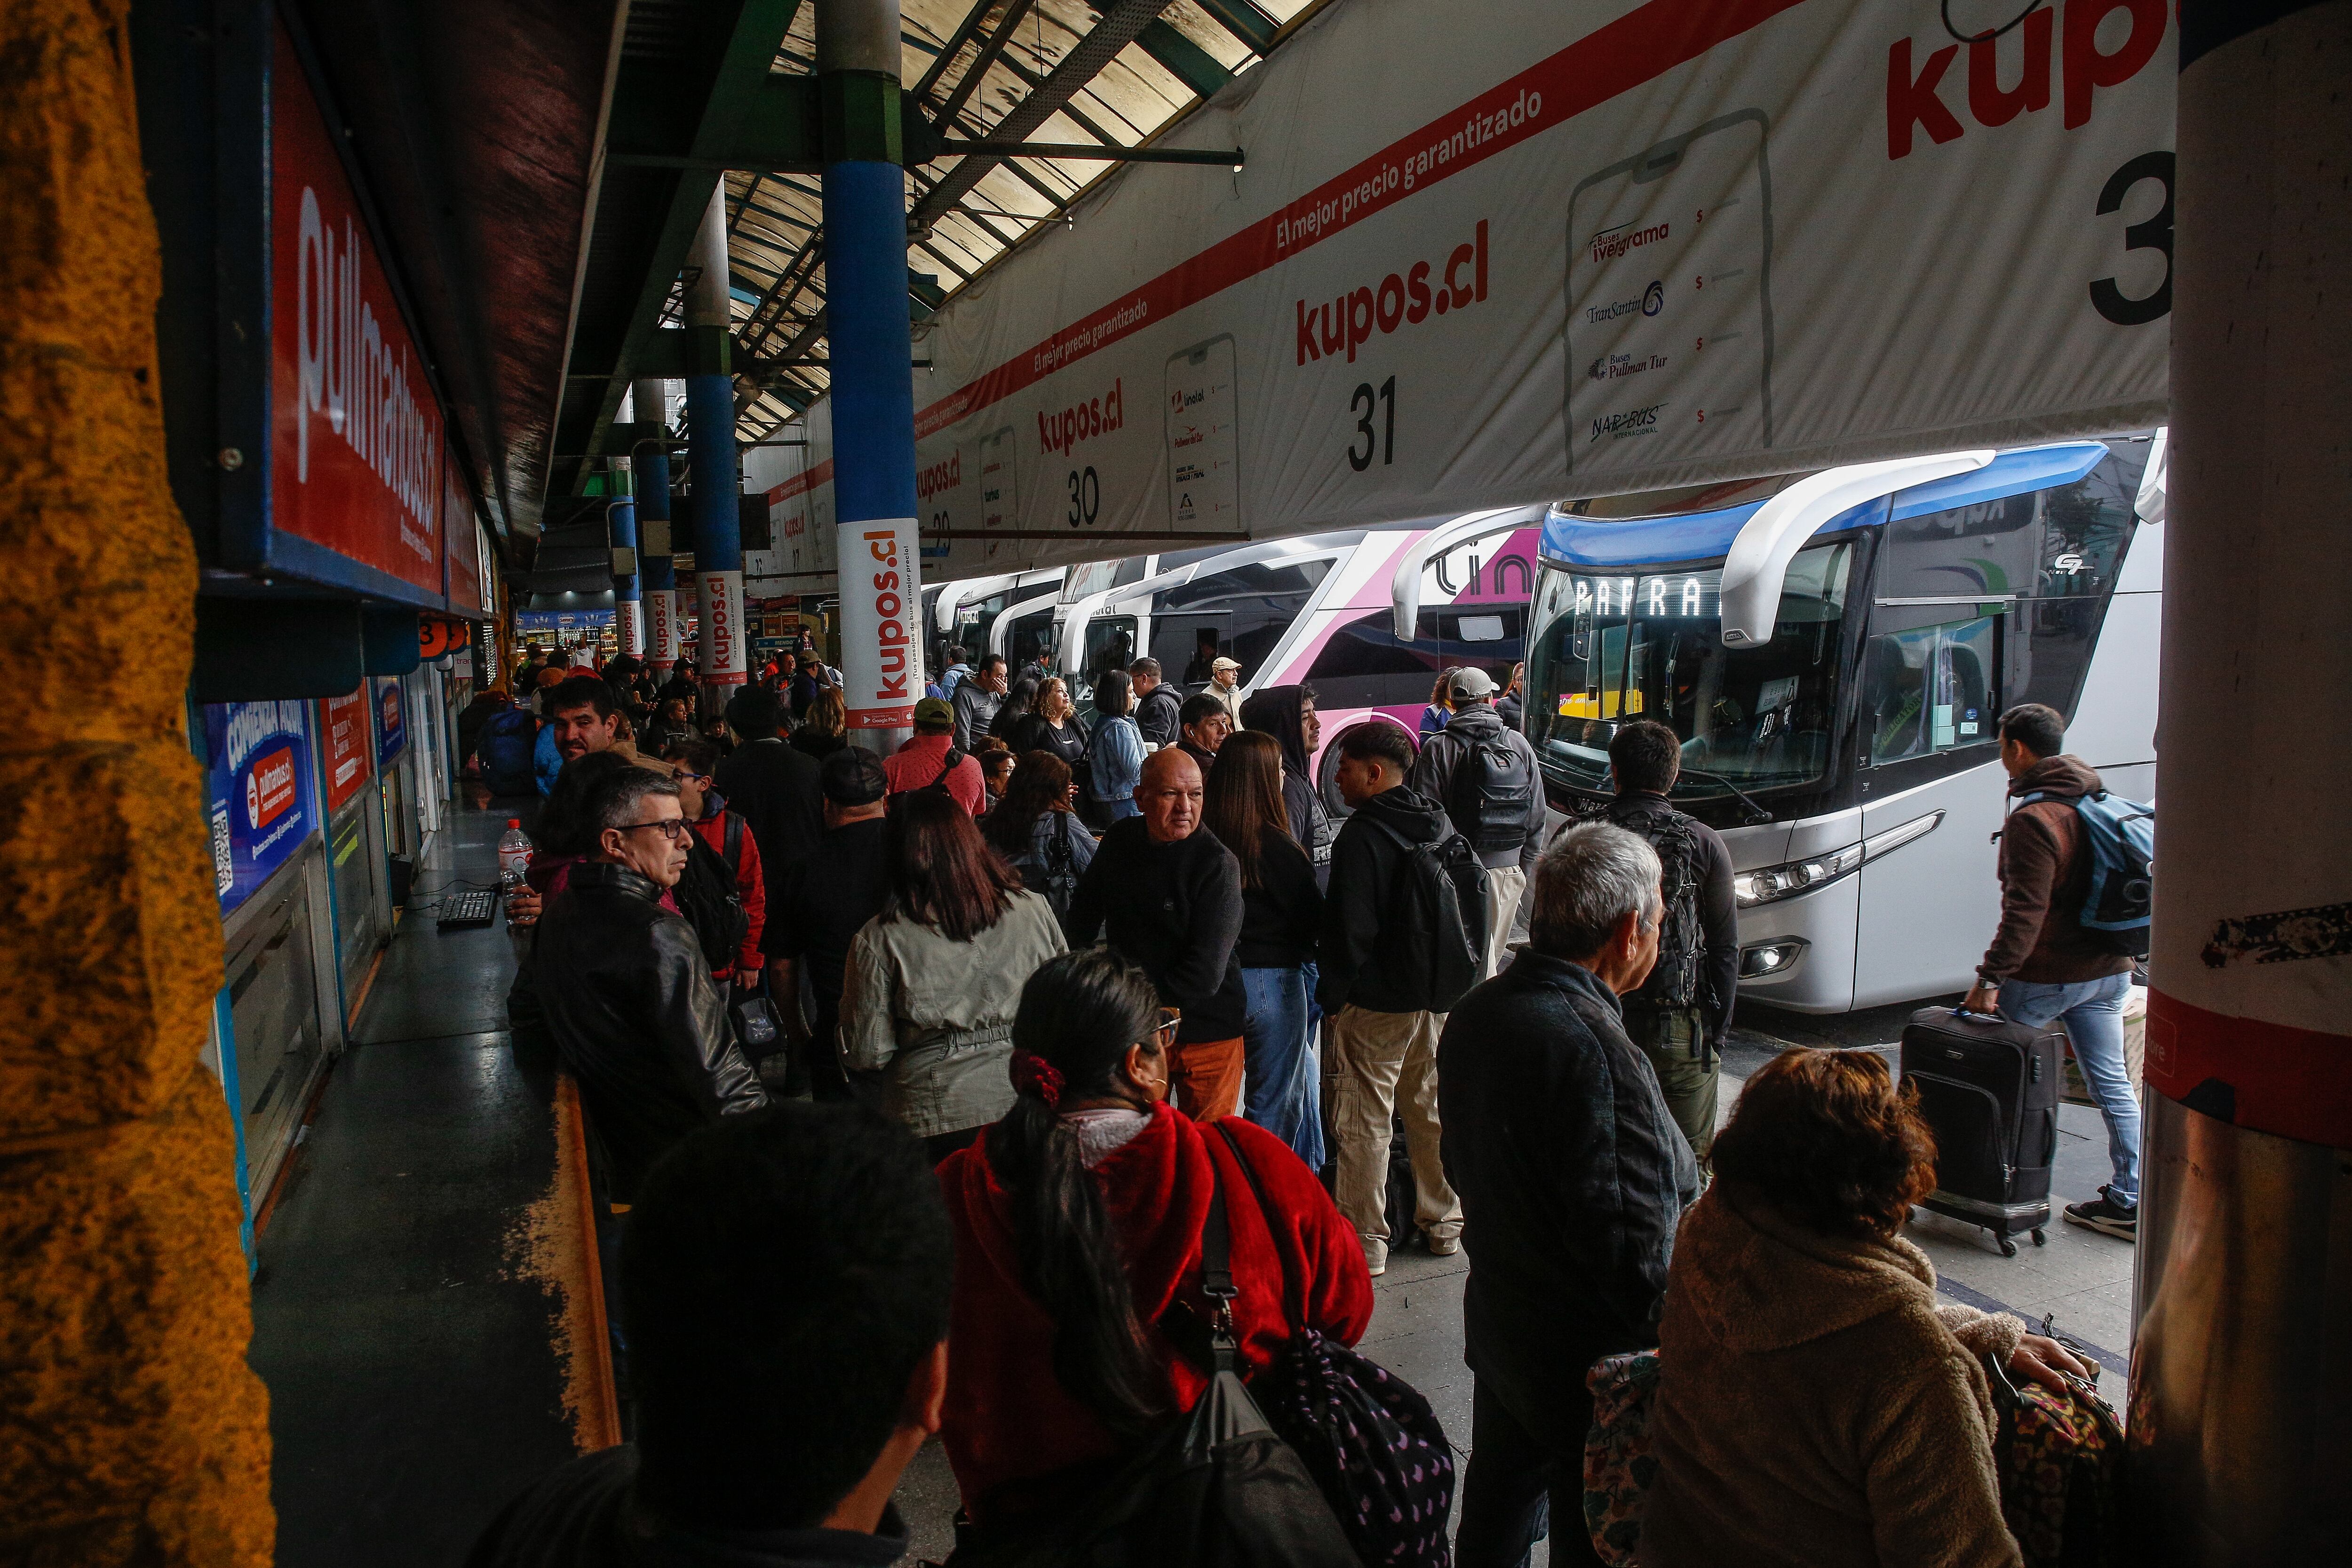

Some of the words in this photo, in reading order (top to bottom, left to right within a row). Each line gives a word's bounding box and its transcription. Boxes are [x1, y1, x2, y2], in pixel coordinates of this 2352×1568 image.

[1886, 0, 2180, 161] kup
[1277, 218, 1289, 249] El
[1292, 201, 1337, 240] mejor
[1343, 164, 1398, 222] precio
[1405, 89, 1542, 189] garantizado
[1597, 232, 1620, 247] Buses
[1696, 209, 1703, 223] $
[1296, 218, 1489, 366] kupos.cl
[1587, 294, 1641, 324] TranSantin
[1695, 275, 1702, 290] $
[1035, 352, 1041, 373] El
[1042, 344, 1064, 368] mejor
[1065, 328, 1090, 361] precio
[1093, 298, 1147, 348] garantizado
[1609, 361, 1646, 379] Pullman
[1650, 355, 1668, 369] Tur
[1696, 336, 1703, 351] $
[1610, 353, 1631, 365] Buses
[1038, 378, 1123, 457] kupos.cl
[1348, 375, 1395, 472] 31
[1613, 427, 1658, 439] INTERNACIONAL
[1697, 408, 1704, 423] $
[1068, 466, 1100, 528] 30
[621, 604, 635, 653] kupos.cl
[652, 594, 669, 658] kupos.cl
[707, 577, 732, 669] kupos.cl
[864, 530, 910, 700] kupos.cl
[911, 622, 915, 631] de
